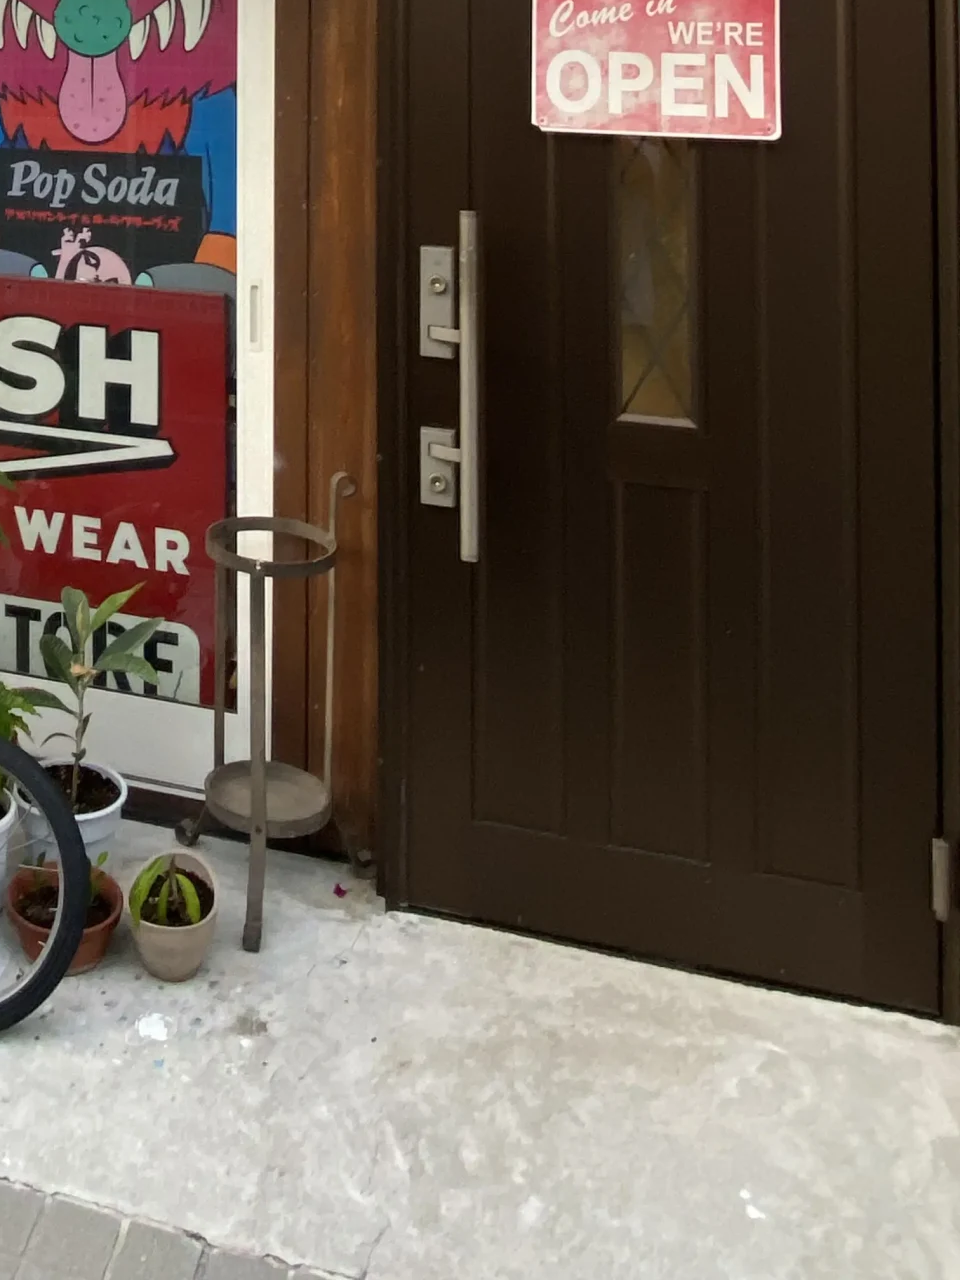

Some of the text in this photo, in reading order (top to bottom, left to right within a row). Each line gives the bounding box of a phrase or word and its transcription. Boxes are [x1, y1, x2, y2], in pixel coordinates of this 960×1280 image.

[549, 0, 634, 38] Come
[667, 21, 764, 47] WE'RE
[546, 49, 765, 119] OPEN
[7, 160, 180, 208] Pop Soda
[13, 505, 191, 577] WEAR
